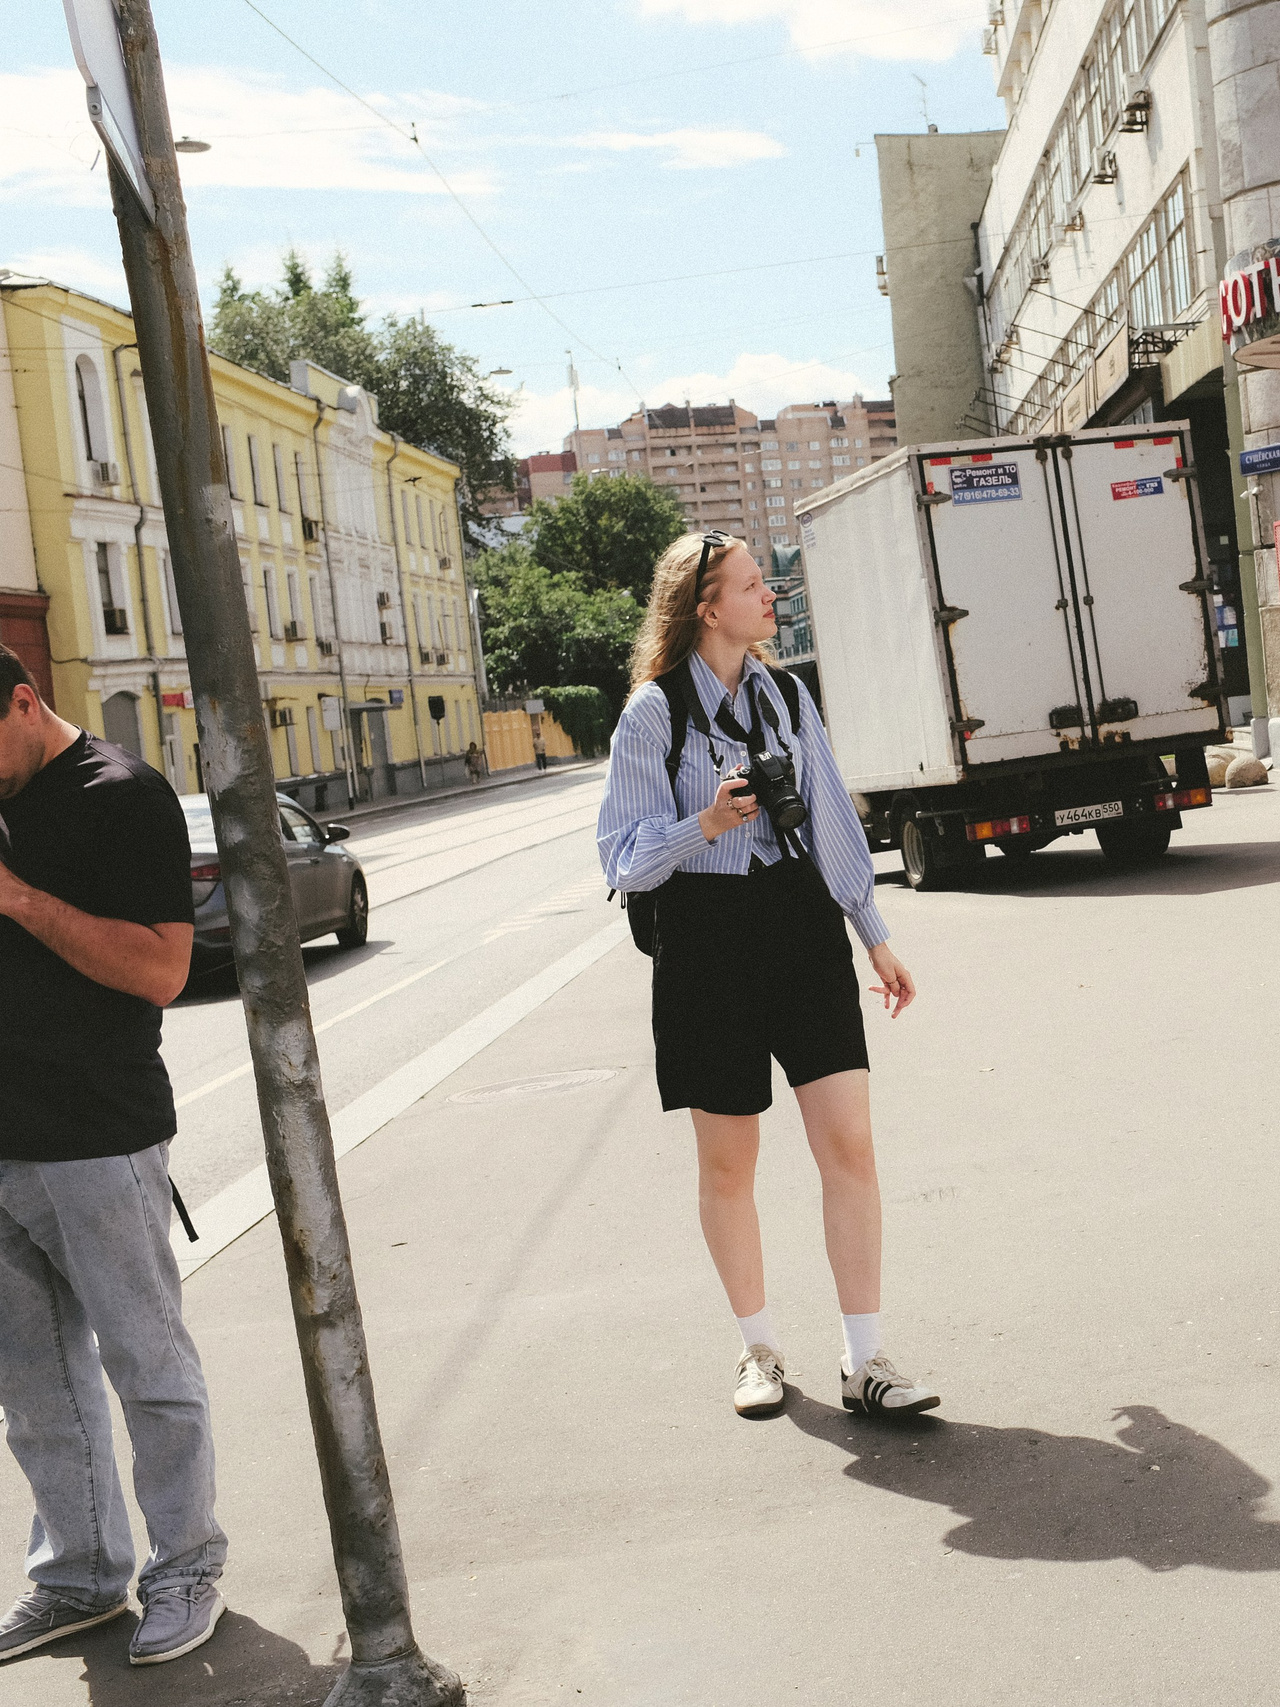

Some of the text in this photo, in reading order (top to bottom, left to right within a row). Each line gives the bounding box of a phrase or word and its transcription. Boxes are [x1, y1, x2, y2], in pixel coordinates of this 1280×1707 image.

[1245, 449, 1280, 464] СУЩЁВСКАЯ
[965, 468, 997, 477] Ремонт
[1004, 465, 1017, 474] ТО
[973, 475, 1013, 487] ГАЗЕЛЬ
[1102, 802, 1120, 814] 550
